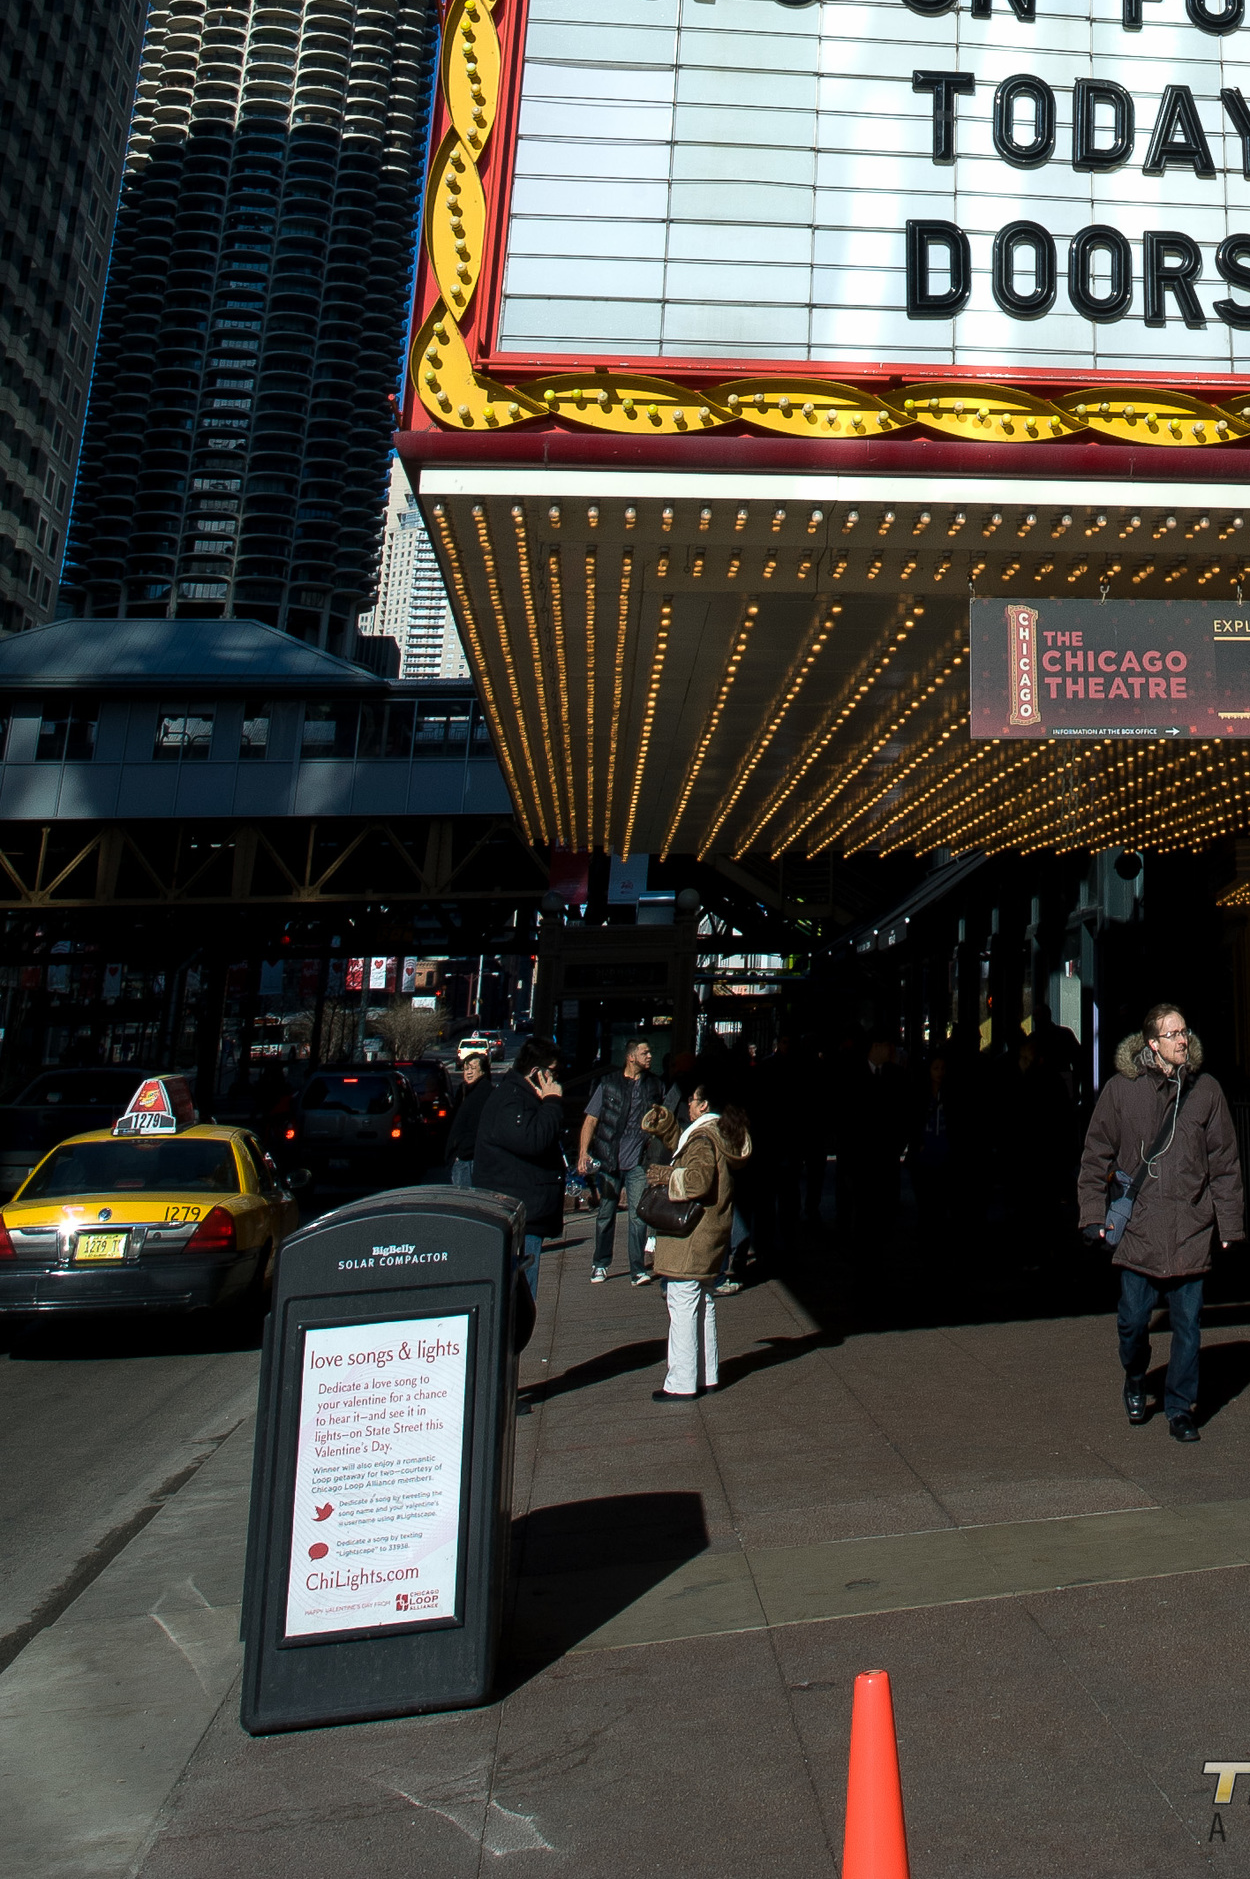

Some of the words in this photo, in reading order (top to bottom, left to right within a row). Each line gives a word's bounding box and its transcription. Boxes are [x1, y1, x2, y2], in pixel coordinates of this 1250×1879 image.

[1043, 631, 1083, 647] THE
[1018, 612, 1033, 718] CHICAGO
[1042, 650, 1188, 673] CHICAGO
[1044, 677, 1188, 700] THEATRE
[133, 1113, 161, 1129] 1279
[164, 1206, 201, 1222] 1279
[84, 1240, 108, 1253] 1279
[372, 1244, 416, 1256] BigBelly
[338, 1257, 375, 1270] SOLAR
[379, 1252, 448, 1266] COMPACTOR
[310, 1351, 343, 1369] love
[347, 1348, 394, 1368] songs
[398, 1341, 411, 1361] &
[418, 1338, 460, 1363] lights
[318, 1381, 362, 1395] Dedicate
[363, 1382, 369, 1390] a
[372, 1378, 392, 1389] love
[394, 1375, 417, 1388] song
[420, 1375, 430, 1384] to
[317, 1399, 341, 1414] your
[343, 1395, 387, 1409] valentine
[389, 1392, 404, 1403] for
[405, 1393, 411, 1401] a
[414, 1389, 447, 1401] chance
[316, 1416, 326, 1426] to
[328, 1414, 351, 1425] hear
[388, 1409, 405, 1419] see
[407, 1406, 415, 1417] it
[416, 1404, 426, 1416] in
[365, 1425, 391, 1438] State
[393, 1421, 423, 1434] Street
[425, 1418, 444, 1431] this
[314, 1442, 368, 1458] Valentine's
[371, 1440, 393, 1455] Day.
[312, 1465, 340, 1475] Winner
[342, 1462, 355, 1471] will
[356, 1461, 372, 1470] also
[374, 1459, 394, 1470] enjoy
[402, 1455, 436, 1464] romantic
[312, 1476, 332, 1486] Loop
[333, 1472, 365, 1484] getaway
[367, 1469, 378, 1478] for
[434, 1463, 442, 1471] of
[311, 1483, 342, 1494] Chicago
[344, 1482, 364, 1492] Loop
[365, 1478, 395, 1489] Alliance
[397, 1475, 434, 1485] members.
[339, 1497, 368, 1507] Dedicate
[402, 1491, 431, 1501] tweeting
[432, 1489, 442, 1497] the
[336, 1538, 366, 1547] Dedicate
[400, 1530, 423, 1541] texting
[306, 1567, 419, 1591] ChiLights.com
[409, 1595, 439, 1605] LOOP
